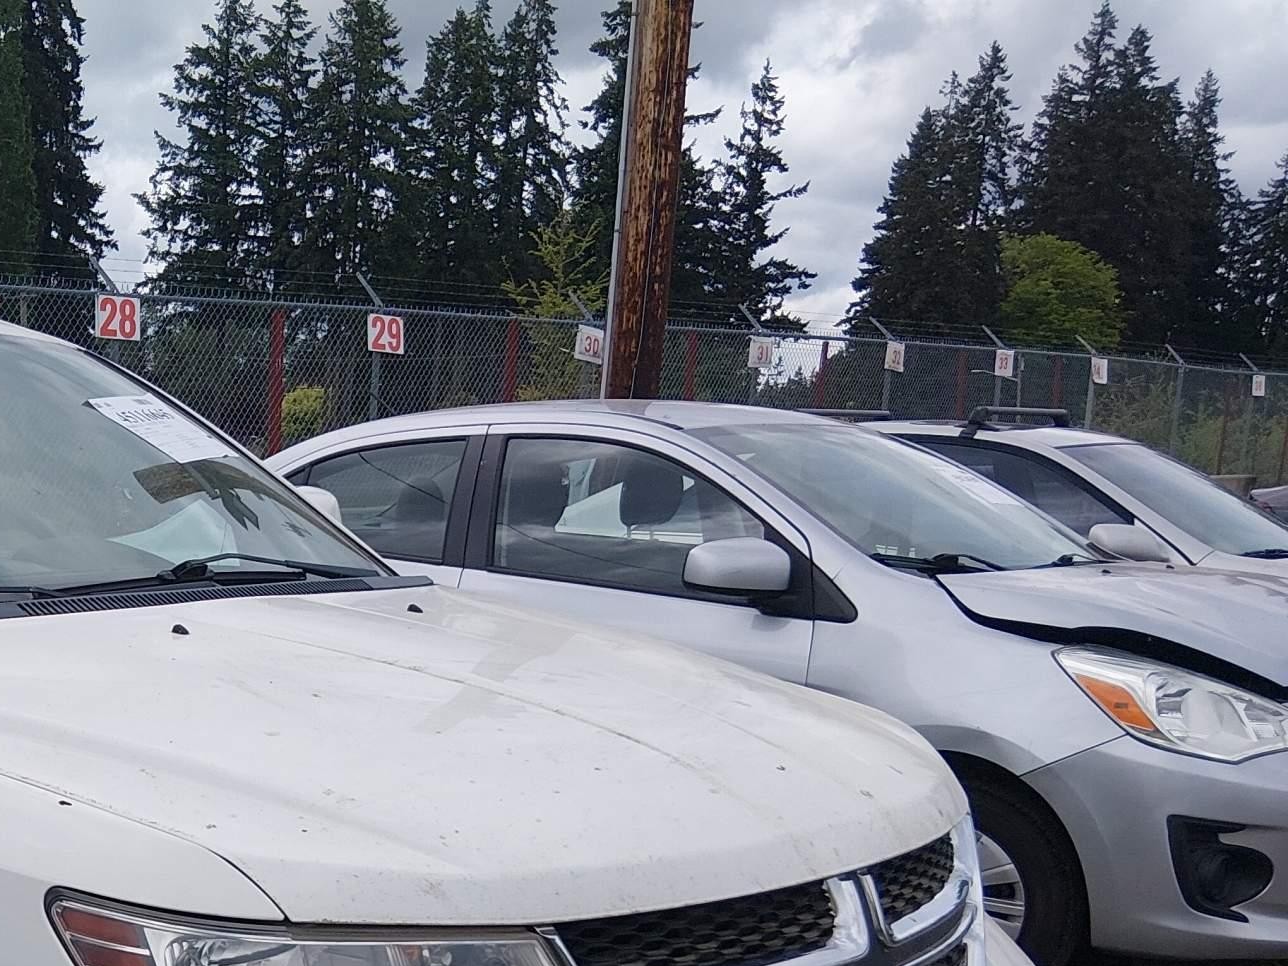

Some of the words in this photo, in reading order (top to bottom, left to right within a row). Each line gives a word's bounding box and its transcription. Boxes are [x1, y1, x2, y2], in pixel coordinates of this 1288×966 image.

[99, 297, 137, 339] 28
[371, 315, 402, 352] 29
[584, 335, 600, 355] 30
[757, 345, 769, 361] 31
[999, 356, 1009, 370] 33
